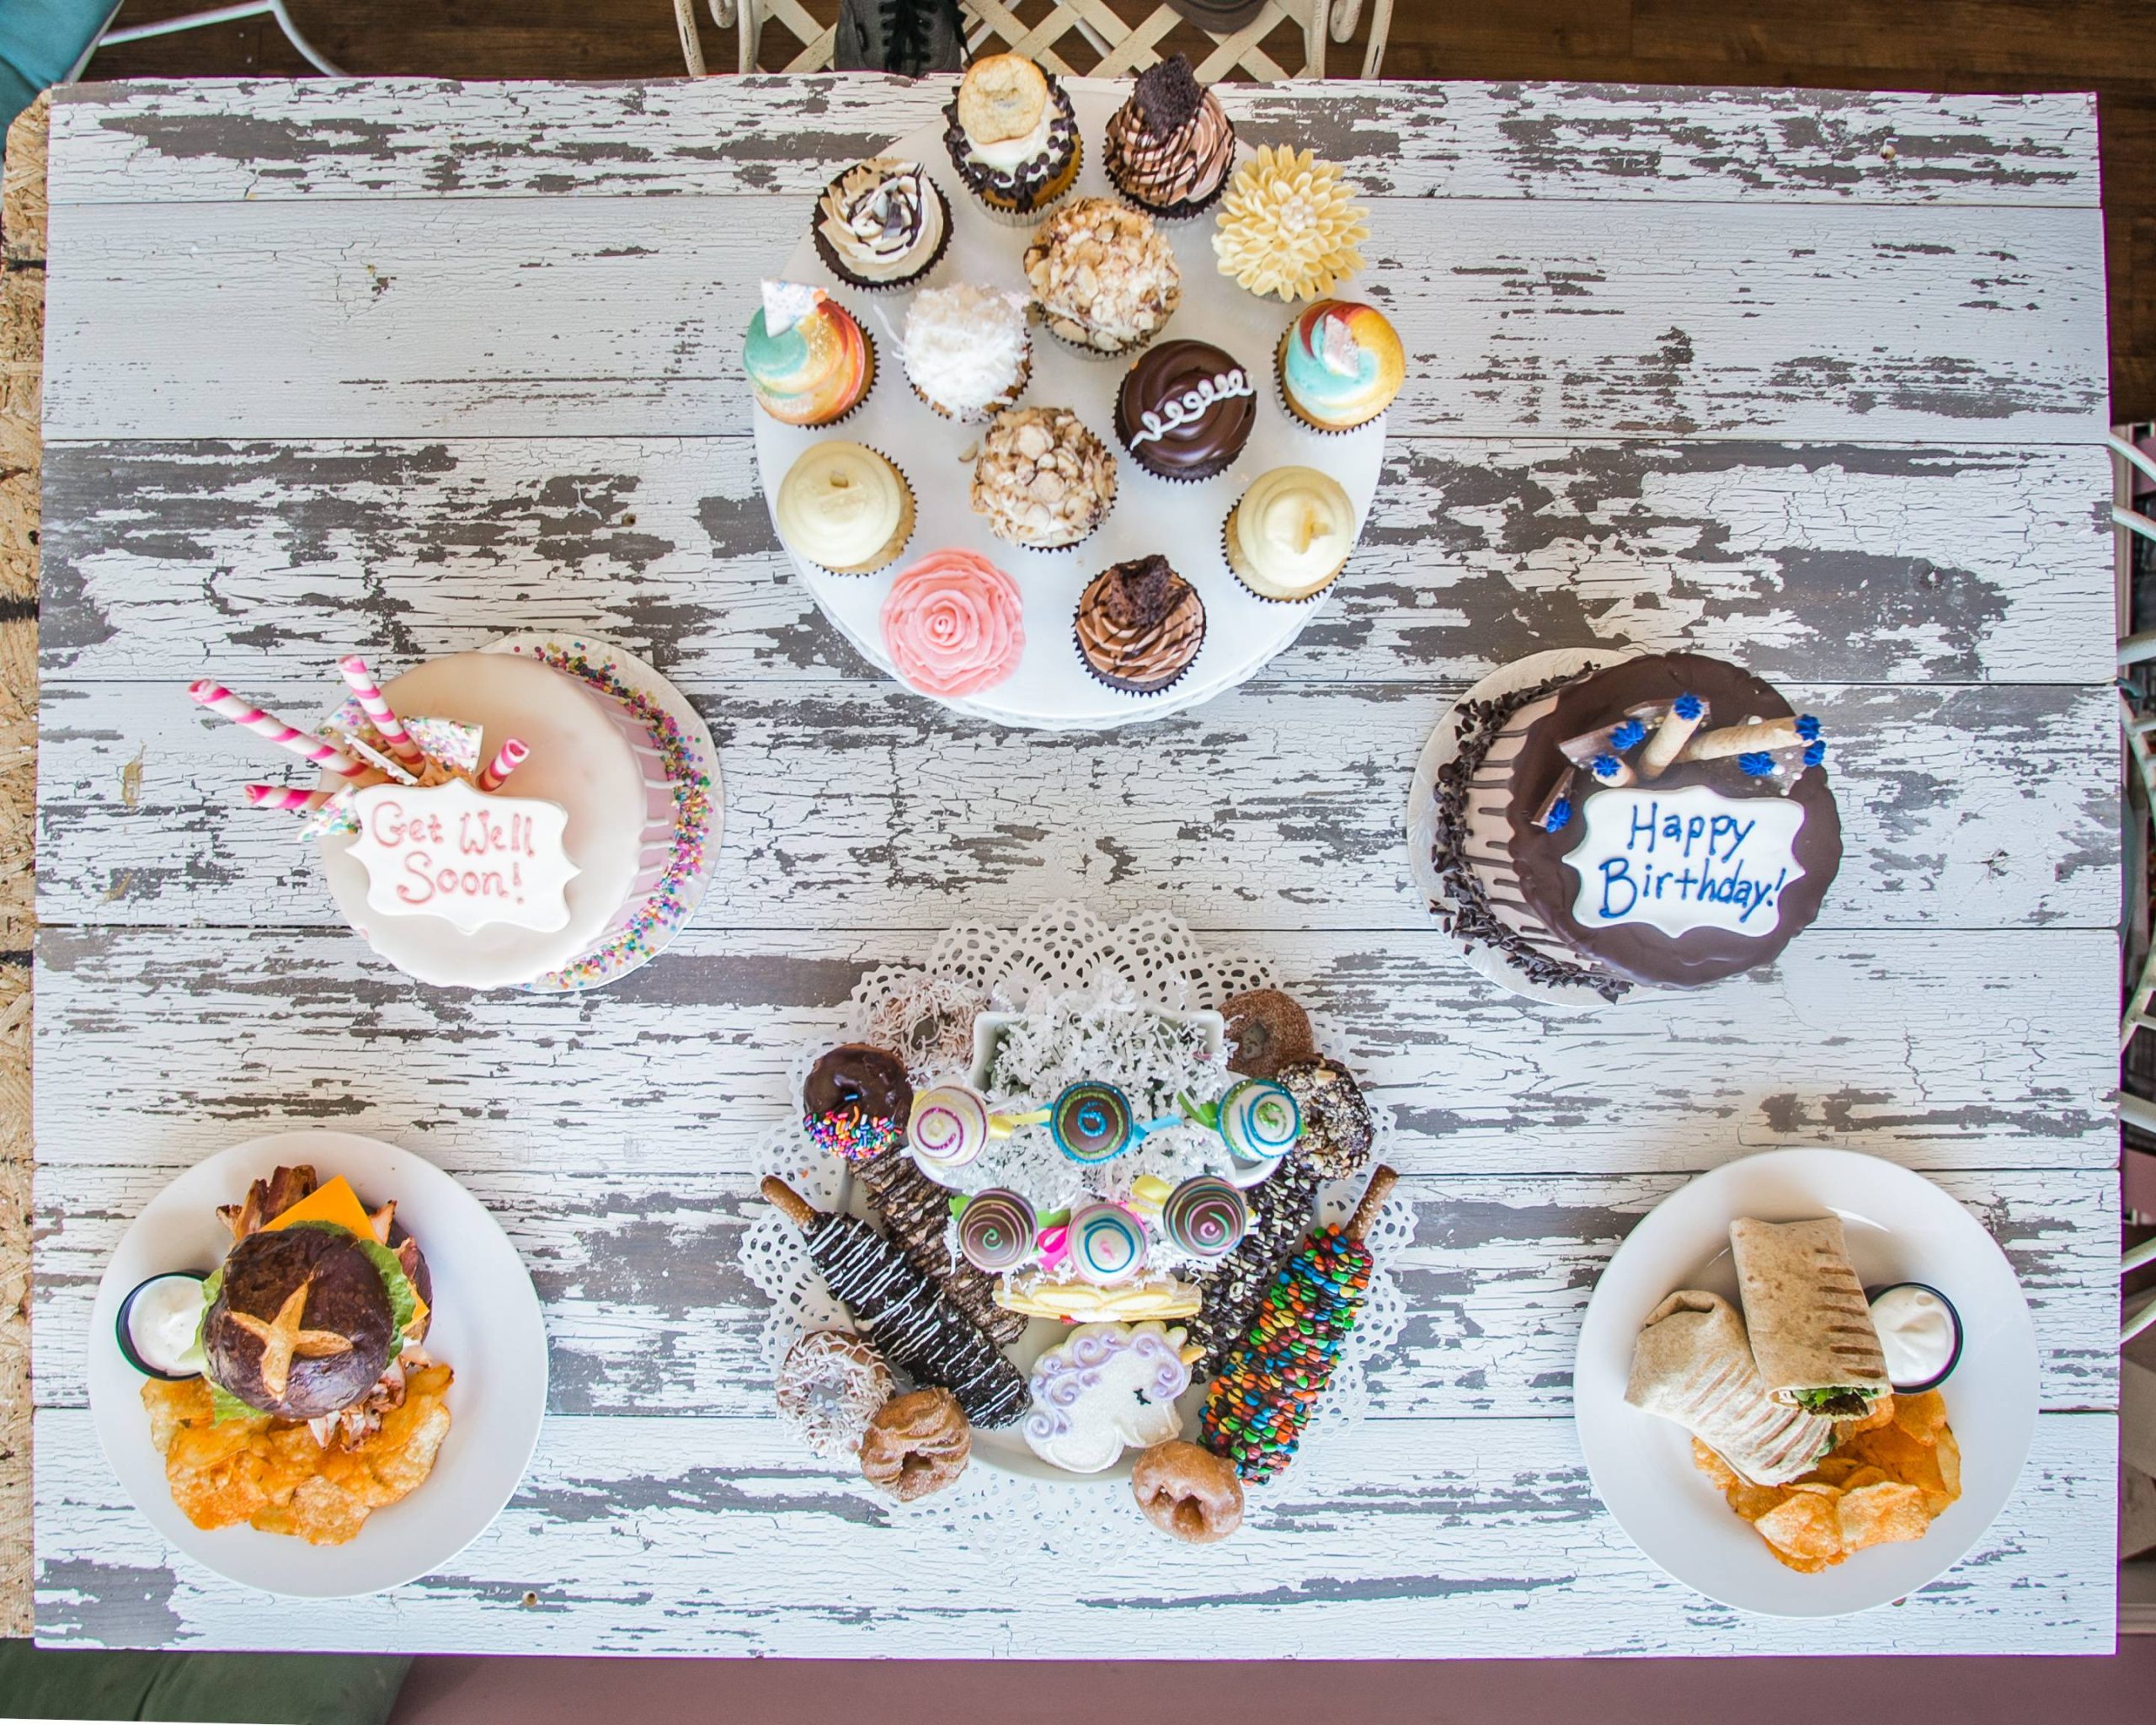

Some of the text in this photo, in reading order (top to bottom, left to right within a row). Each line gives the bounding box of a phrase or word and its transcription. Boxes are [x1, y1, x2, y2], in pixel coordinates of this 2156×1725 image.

[372, 801, 535, 857] Get Well
[1626, 802, 1755, 863] Happy
[397, 851, 525, 905] Soon!
[1598, 857, 1786, 923] Birthday!
